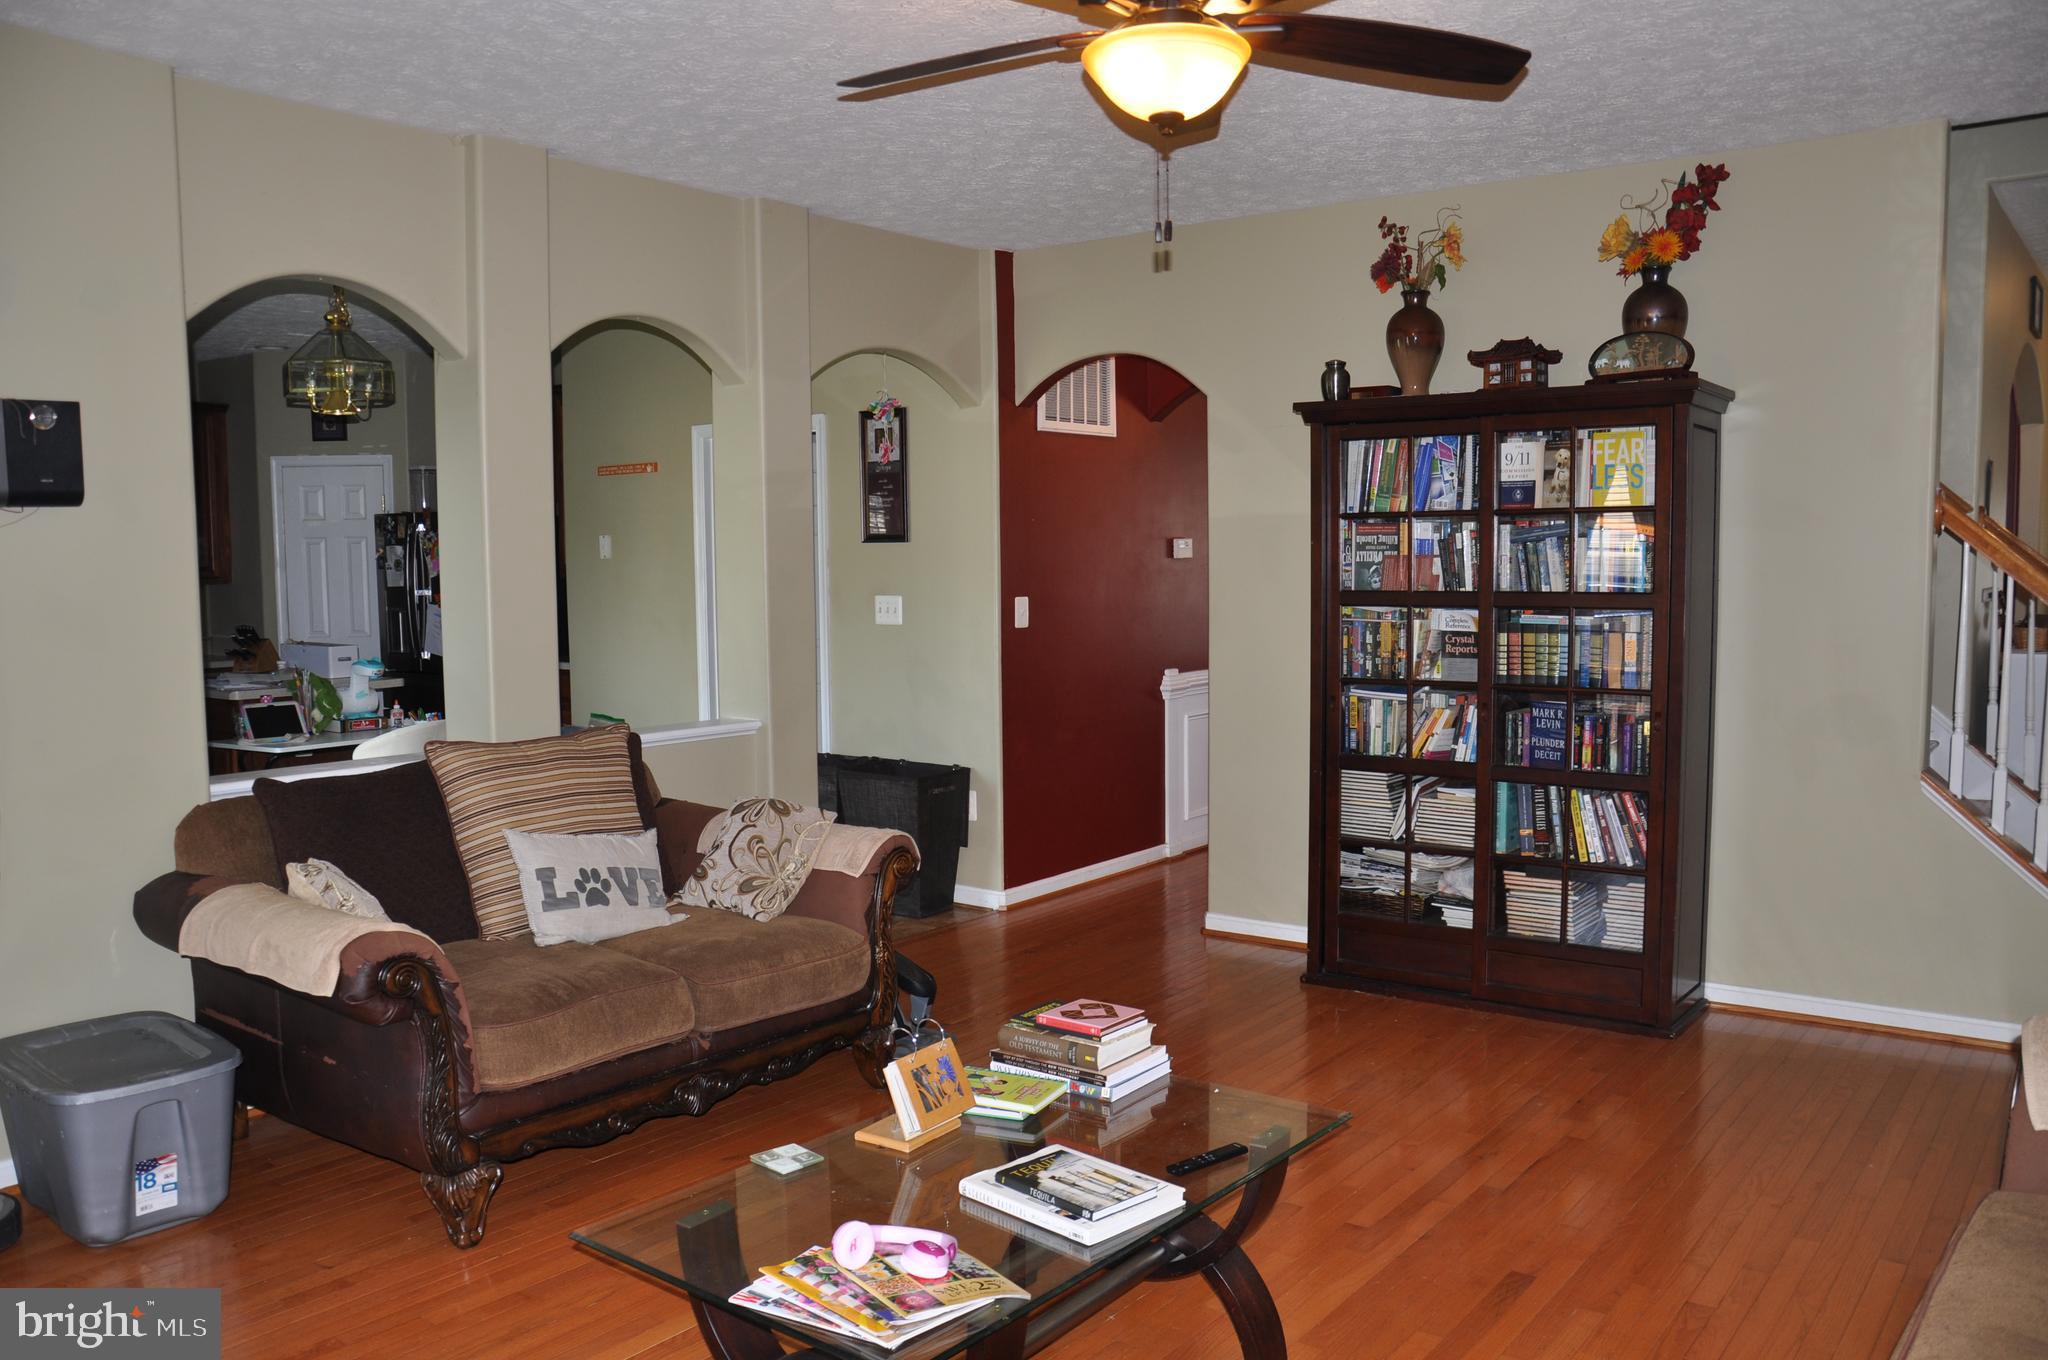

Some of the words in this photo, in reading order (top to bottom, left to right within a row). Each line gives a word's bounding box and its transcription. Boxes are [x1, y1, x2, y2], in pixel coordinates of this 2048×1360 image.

[1504, 450, 1530, 467] 9/11
[1592, 437, 1645, 465] FEAR
[1592, 463, 1645, 491] LES
[1445, 633, 1475, 646] Crystal
[1445, 643, 1478, 656] Reports
[1532, 707, 1556, 718] MARK
[1557, 709, 1565, 720] R.
[1536, 718, 1561, 730] LEVIN
[1531, 735, 1565, 749] PLUNDER
[1534, 750, 1561, 761] DECEIT
[1535, 803, 1547, 831] FAMILIES
[1009, 1040, 1024, 1050] OLD
[1024, 1044, 1063, 1059] TESTAMENT
[1019, 1034, 1038, 1046] SURVEY
[1049, 1041, 1060, 1050] THE
[1057, 1066, 1080, 1075] TESTAMENT
[1057, 1071, 1080, 1080] TESTAMENT
[135, 1172, 157, 1192] 18
[1029, 1187, 1056, 1205] TEQUILA
